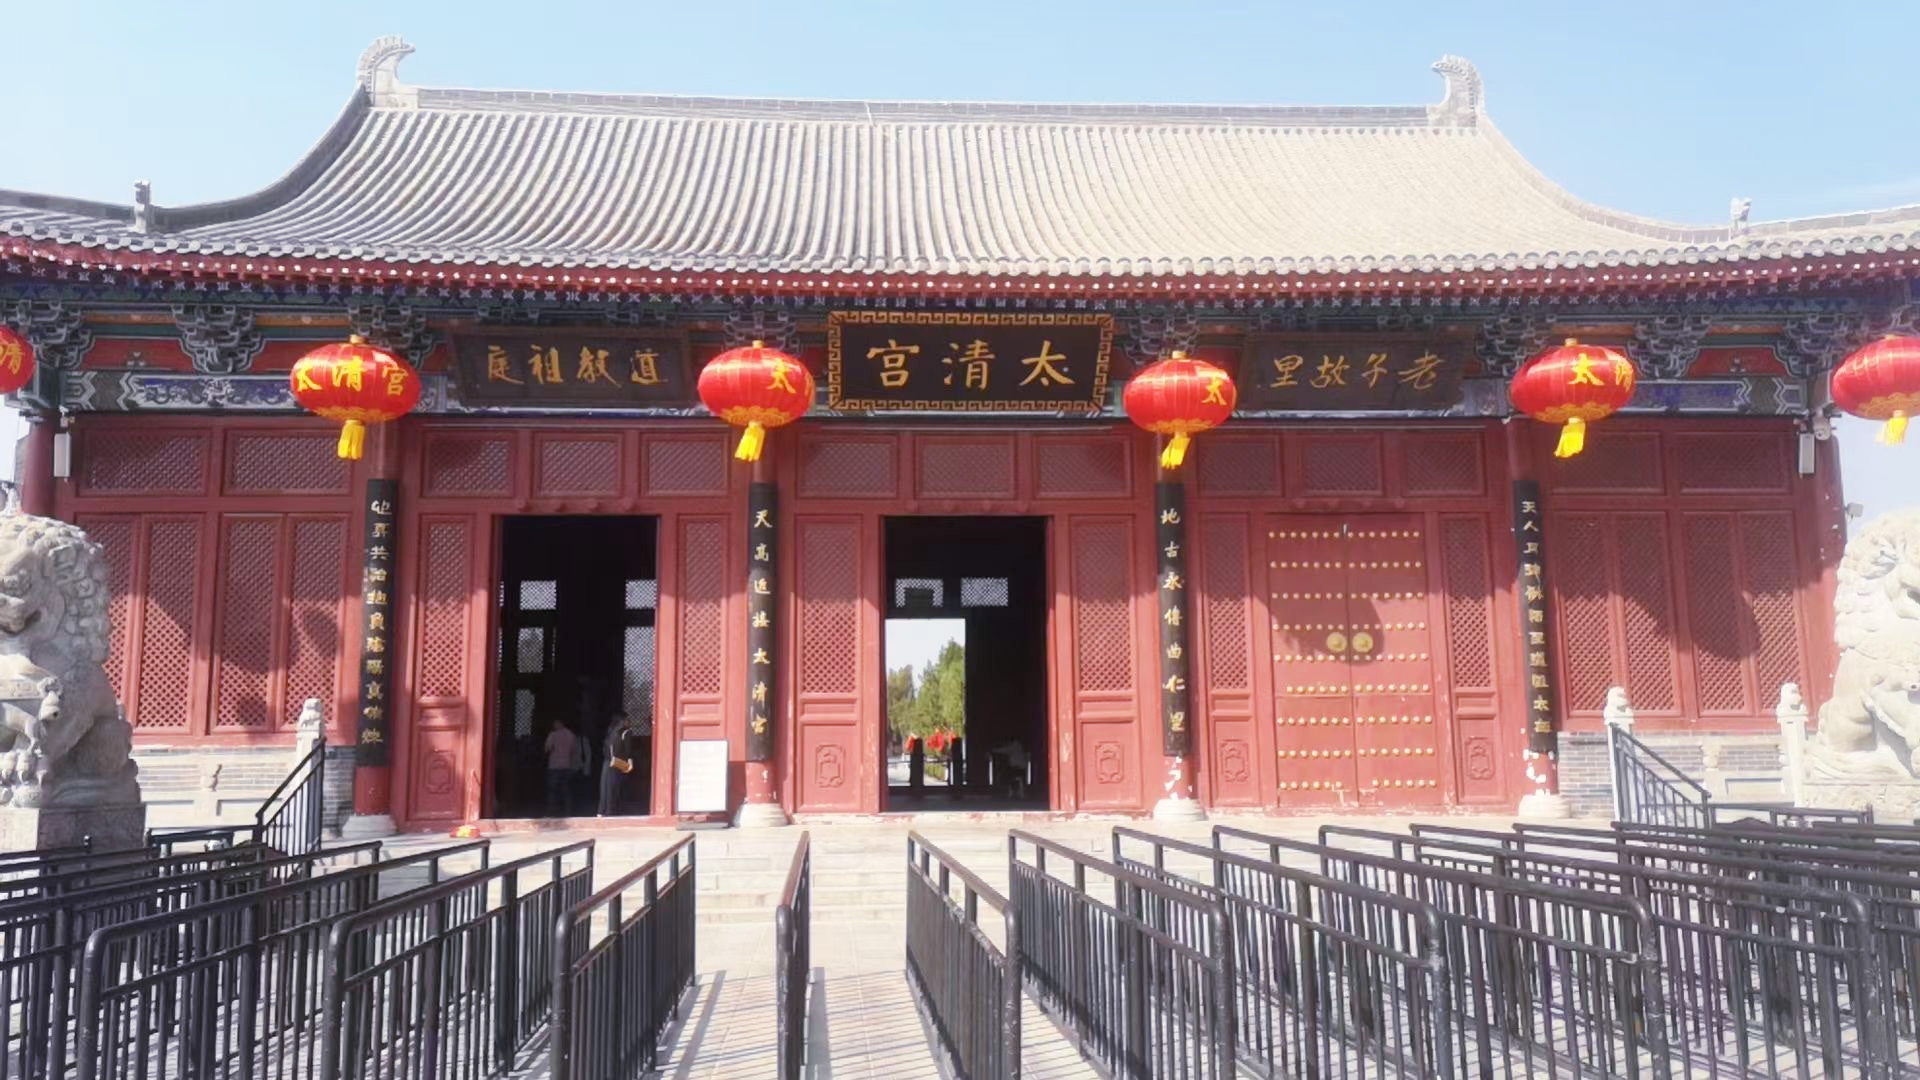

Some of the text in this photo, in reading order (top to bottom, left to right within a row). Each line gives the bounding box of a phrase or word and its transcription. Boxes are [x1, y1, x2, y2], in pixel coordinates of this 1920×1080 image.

[866, 339, 1075, 390] 太清宫
[1270, 349, 1446, 390] 老子故里
